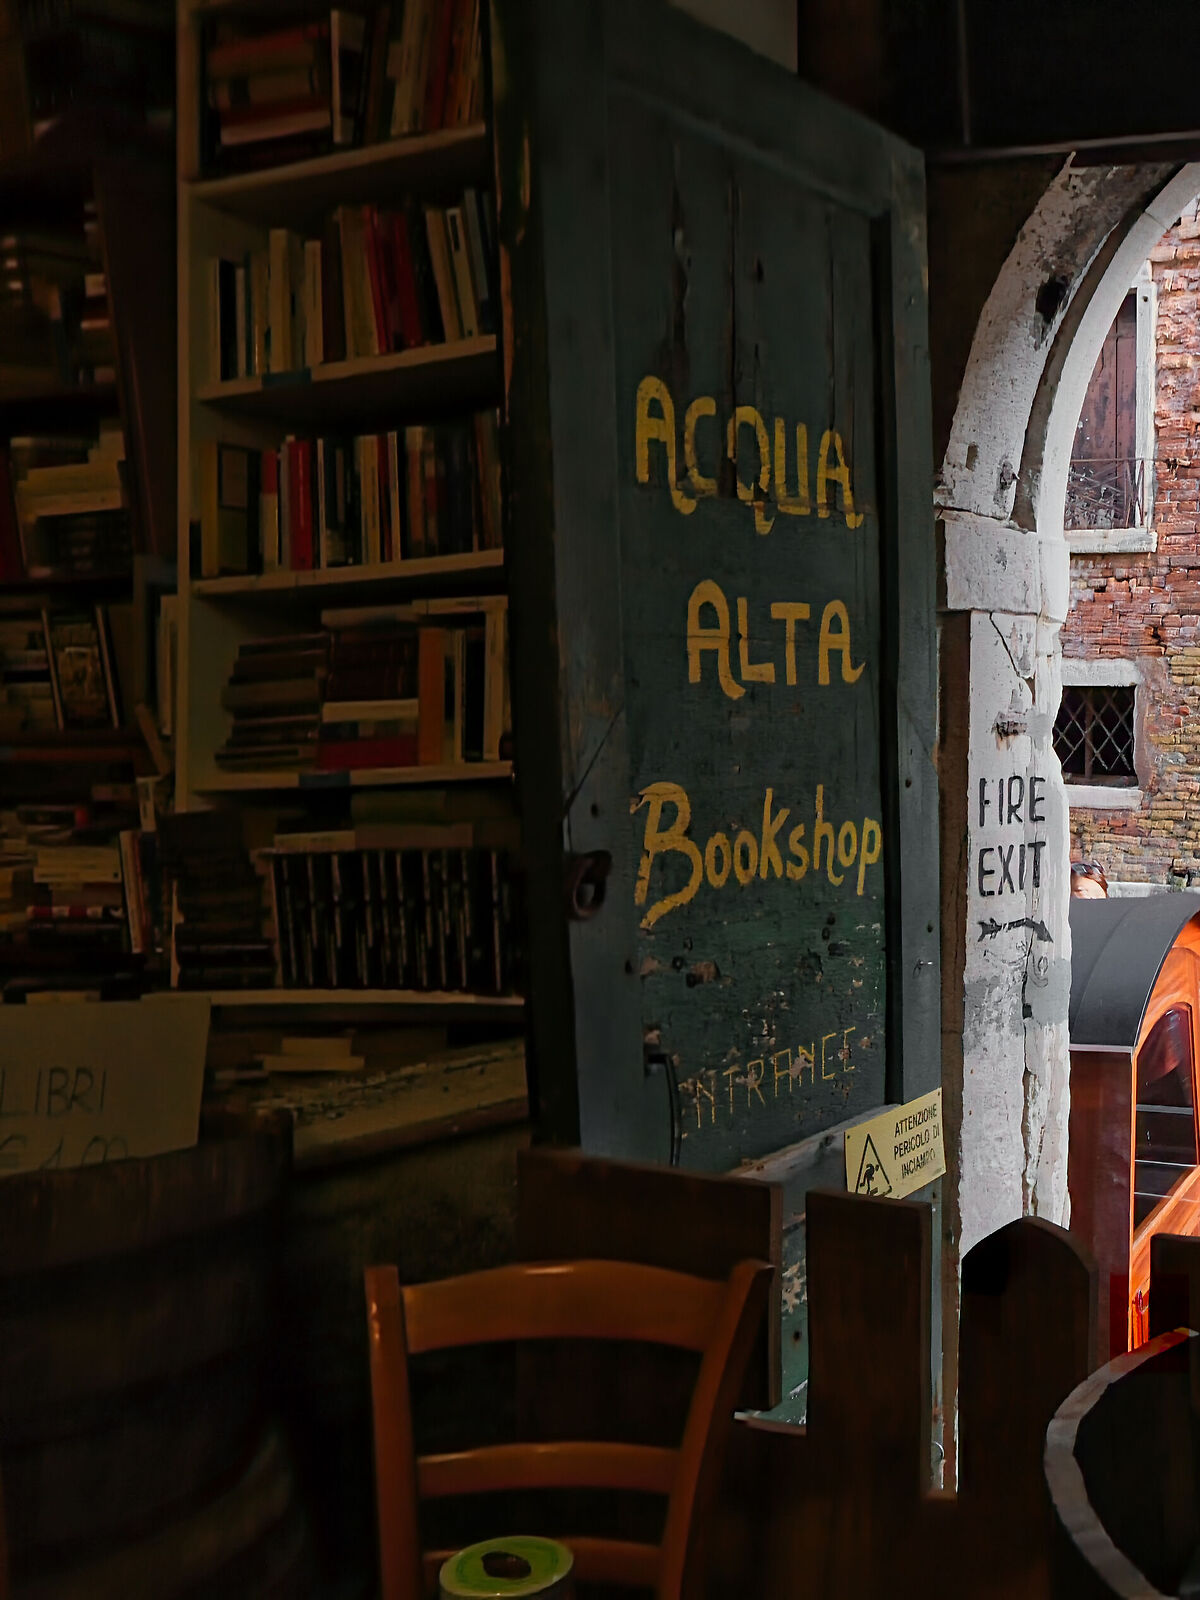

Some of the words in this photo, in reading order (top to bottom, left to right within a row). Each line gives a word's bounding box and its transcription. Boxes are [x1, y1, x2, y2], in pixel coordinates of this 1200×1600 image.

[635, 375, 864, 536] ACQUA
[687, 579, 866, 700] ALTA
[979, 775, 1046, 827] FIRE
[630, 781, 883, 931] Bookshop
[979, 841, 1046, 896] EXIT
[0, 1066, 108, 1118] LIBRI
[678, 1027, 857, 1138] NTRANCE
[894, 1103, 938, 1138] ATTENZIONE
[894, 1129, 930, 1160] PERICOLO
[933, 1123, 940, 1139] DI
[901, 1147, 936, 1179] INCIAMPO
